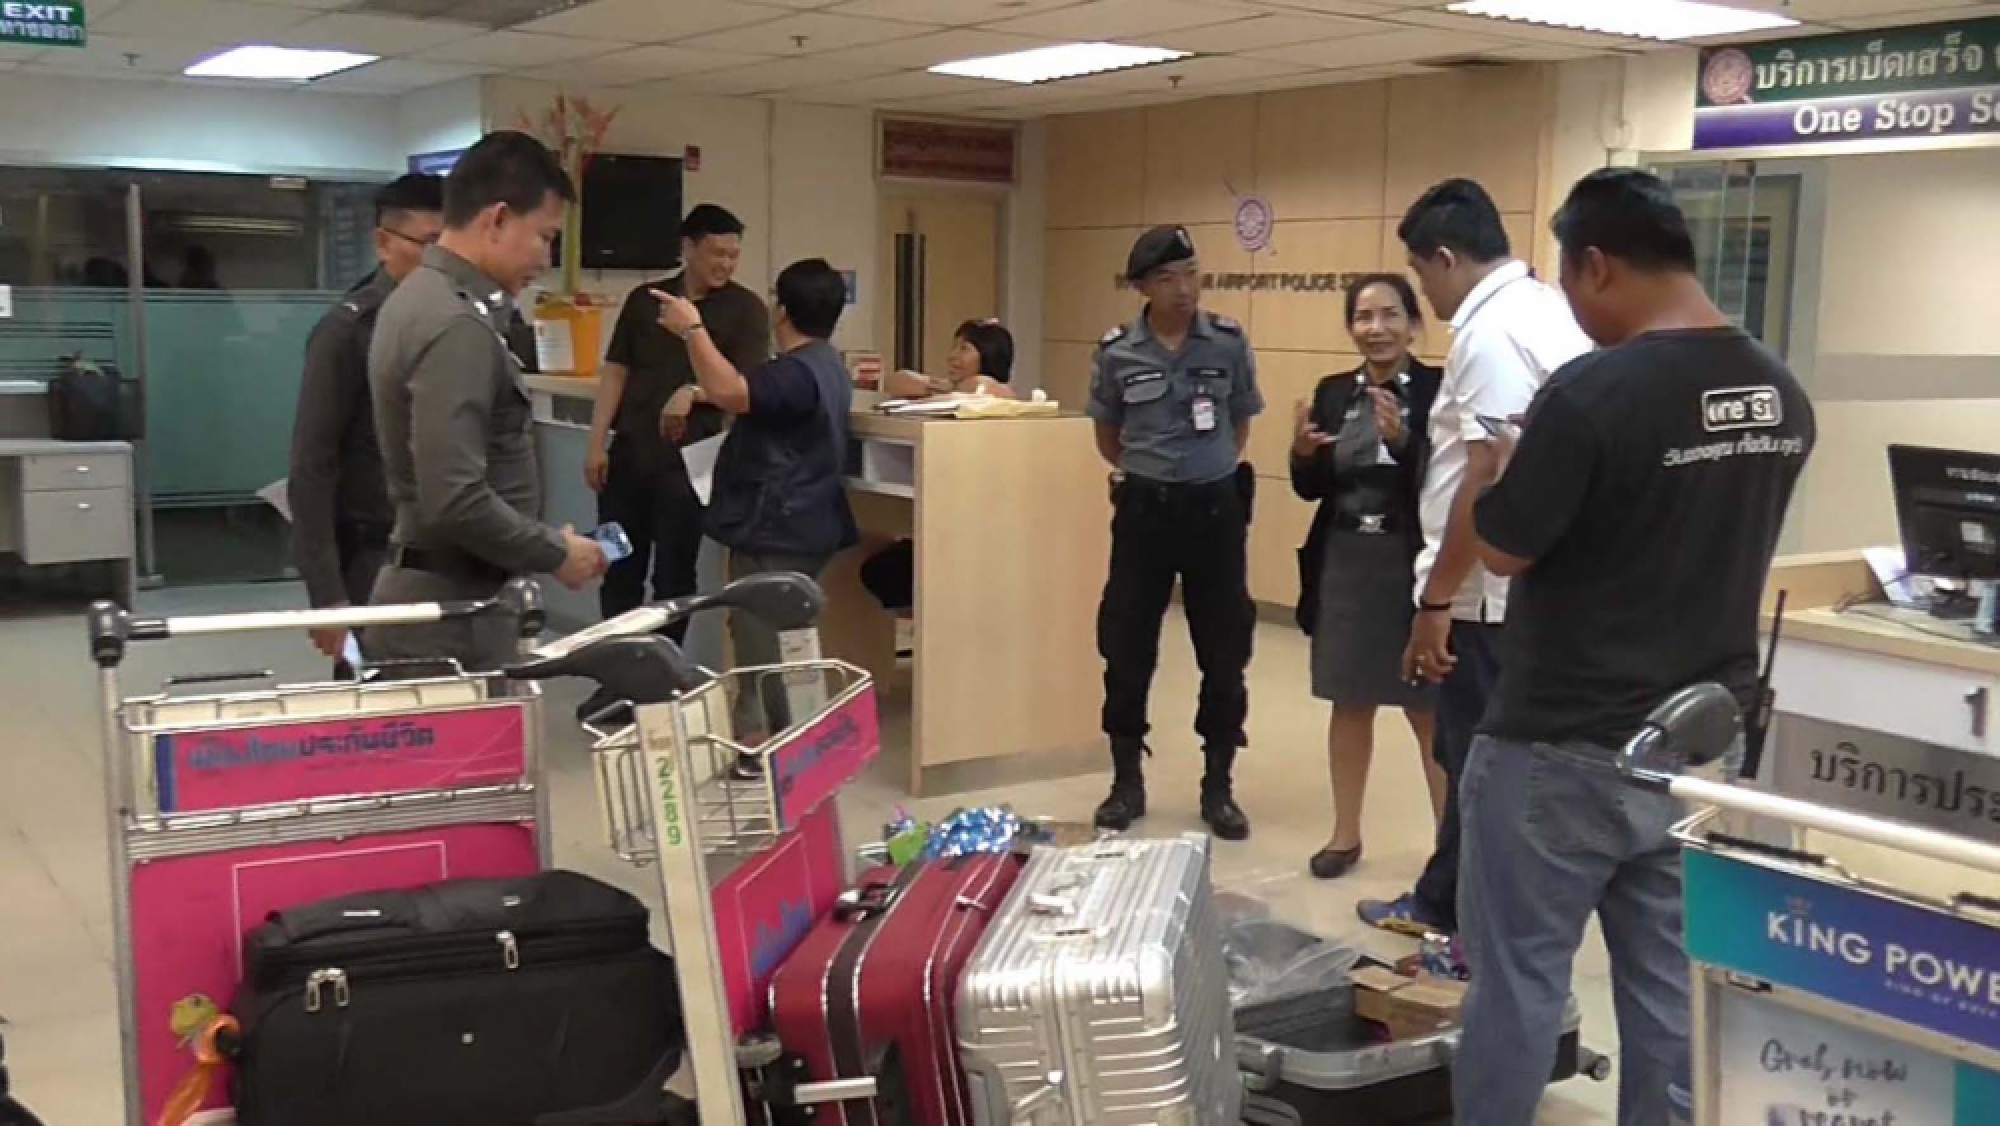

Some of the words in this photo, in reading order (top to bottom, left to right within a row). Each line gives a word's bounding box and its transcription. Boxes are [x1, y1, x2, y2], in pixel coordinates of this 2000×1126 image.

[3, 2, 75, 21] EXIT
[1793, 104, 1863, 135] One
[1873, 98, 1956, 133] Stop
[1281, 272, 1337, 292] POLICE
[1964, 686, 1988, 739] 1
[1767, 911, 1872, 965] KING
